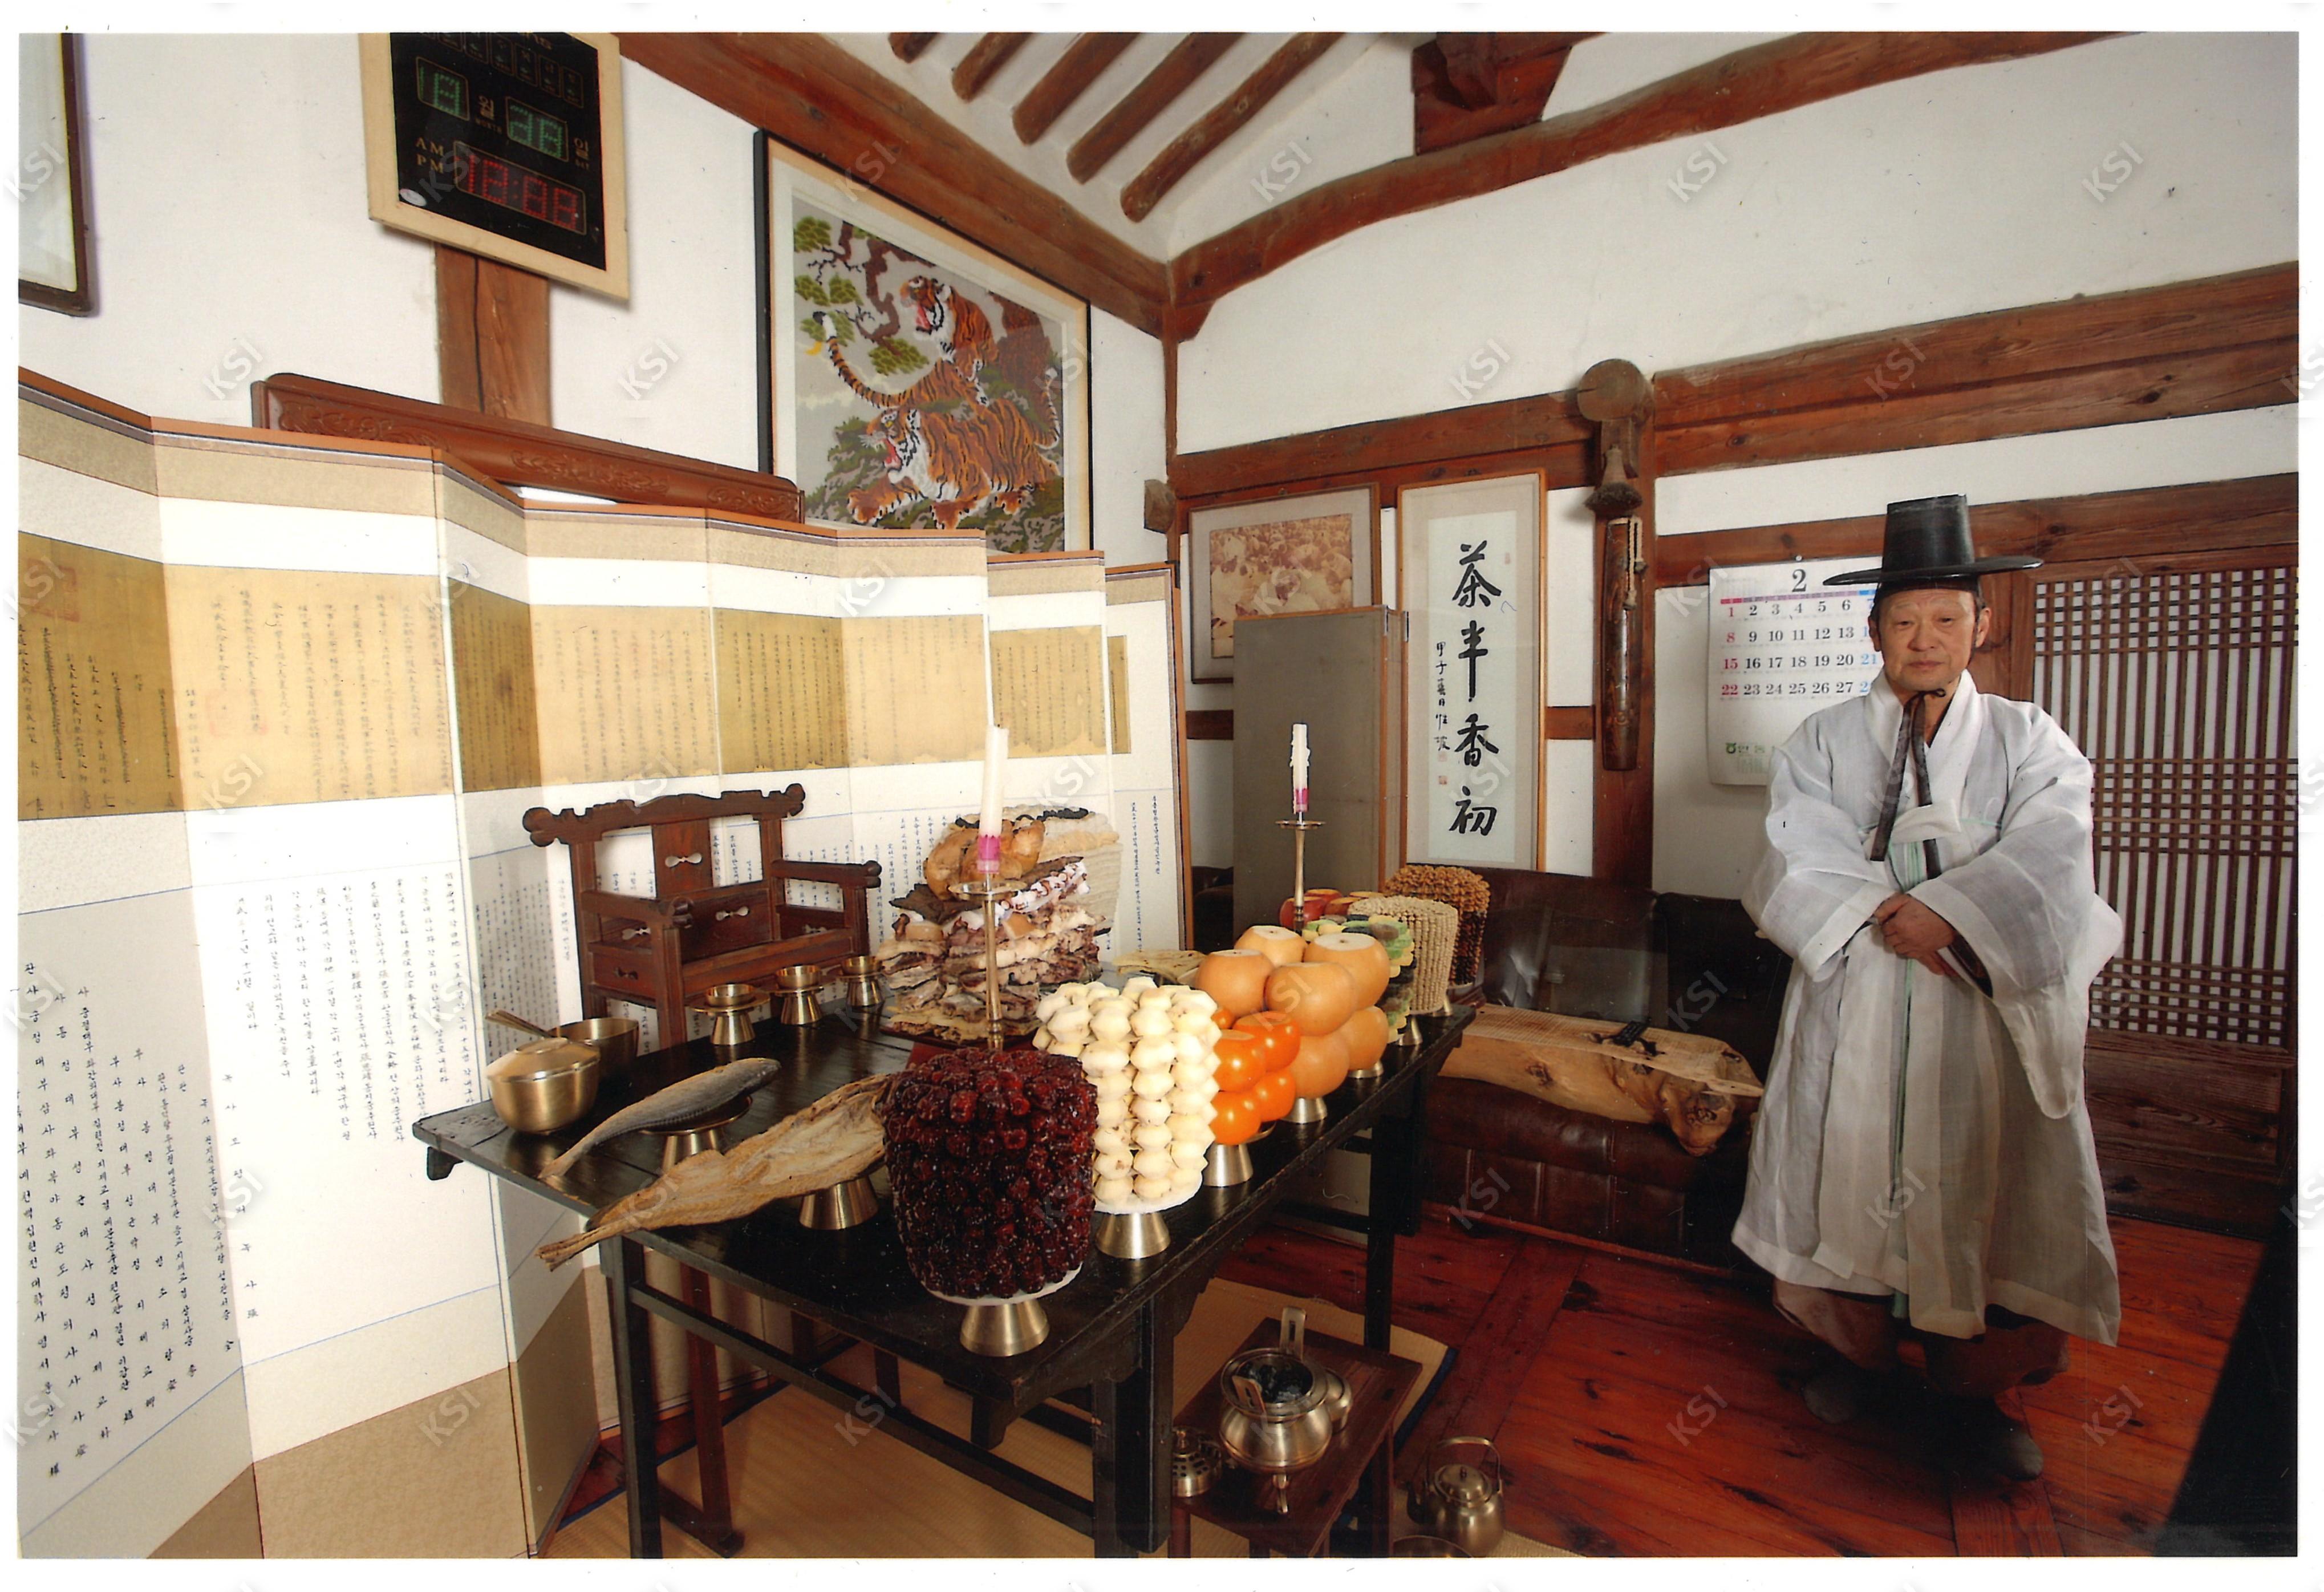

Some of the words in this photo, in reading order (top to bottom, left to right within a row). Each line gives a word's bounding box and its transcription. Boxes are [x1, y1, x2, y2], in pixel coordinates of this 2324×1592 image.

[415, 136, 445, 157] AM
[415, 155, 445, 175] PM
[1791, 569, 1807, 593] 2
[1728, 607, 1734, 618] 1
[1749, 605, 1757, 616] 2
[1771, 604, 1780, 615] 3
[1794, 603, 1802, 614] 4
[1818, 601, 1826, 612] 5
[1842, 599, 1851, 610] 6
[1726, 632, 1735, 643] 8
[1749, 631, 1757, 642] 9
[1769, 630, 1783, 642] 10
[1793, 629, 1804, 641] 11
[1815, 628, 1831, 639] 12
[1839, 627, 1854, 638] 13
[1724, 658, 1738, 670] 15
[1746, 658, 1761, 669] 16
[1769, 657, 1783, 669] 17
[1791, 657, 1807, 667] 18
[1815, 655, 1830, 667] 19
[1836, 654, 1854, 666] 20
[1861, 654, 1876, 665] 21
[1721, 684, 1738, 695] 22
[1743, 684, 1760, 695] 23
[1766, 683, 1782, 695] 24
[1789, 683, 1806, 695] 25
[1812, 682, 1830, 694] 26
[1836, 682, 1853, 694] 27
